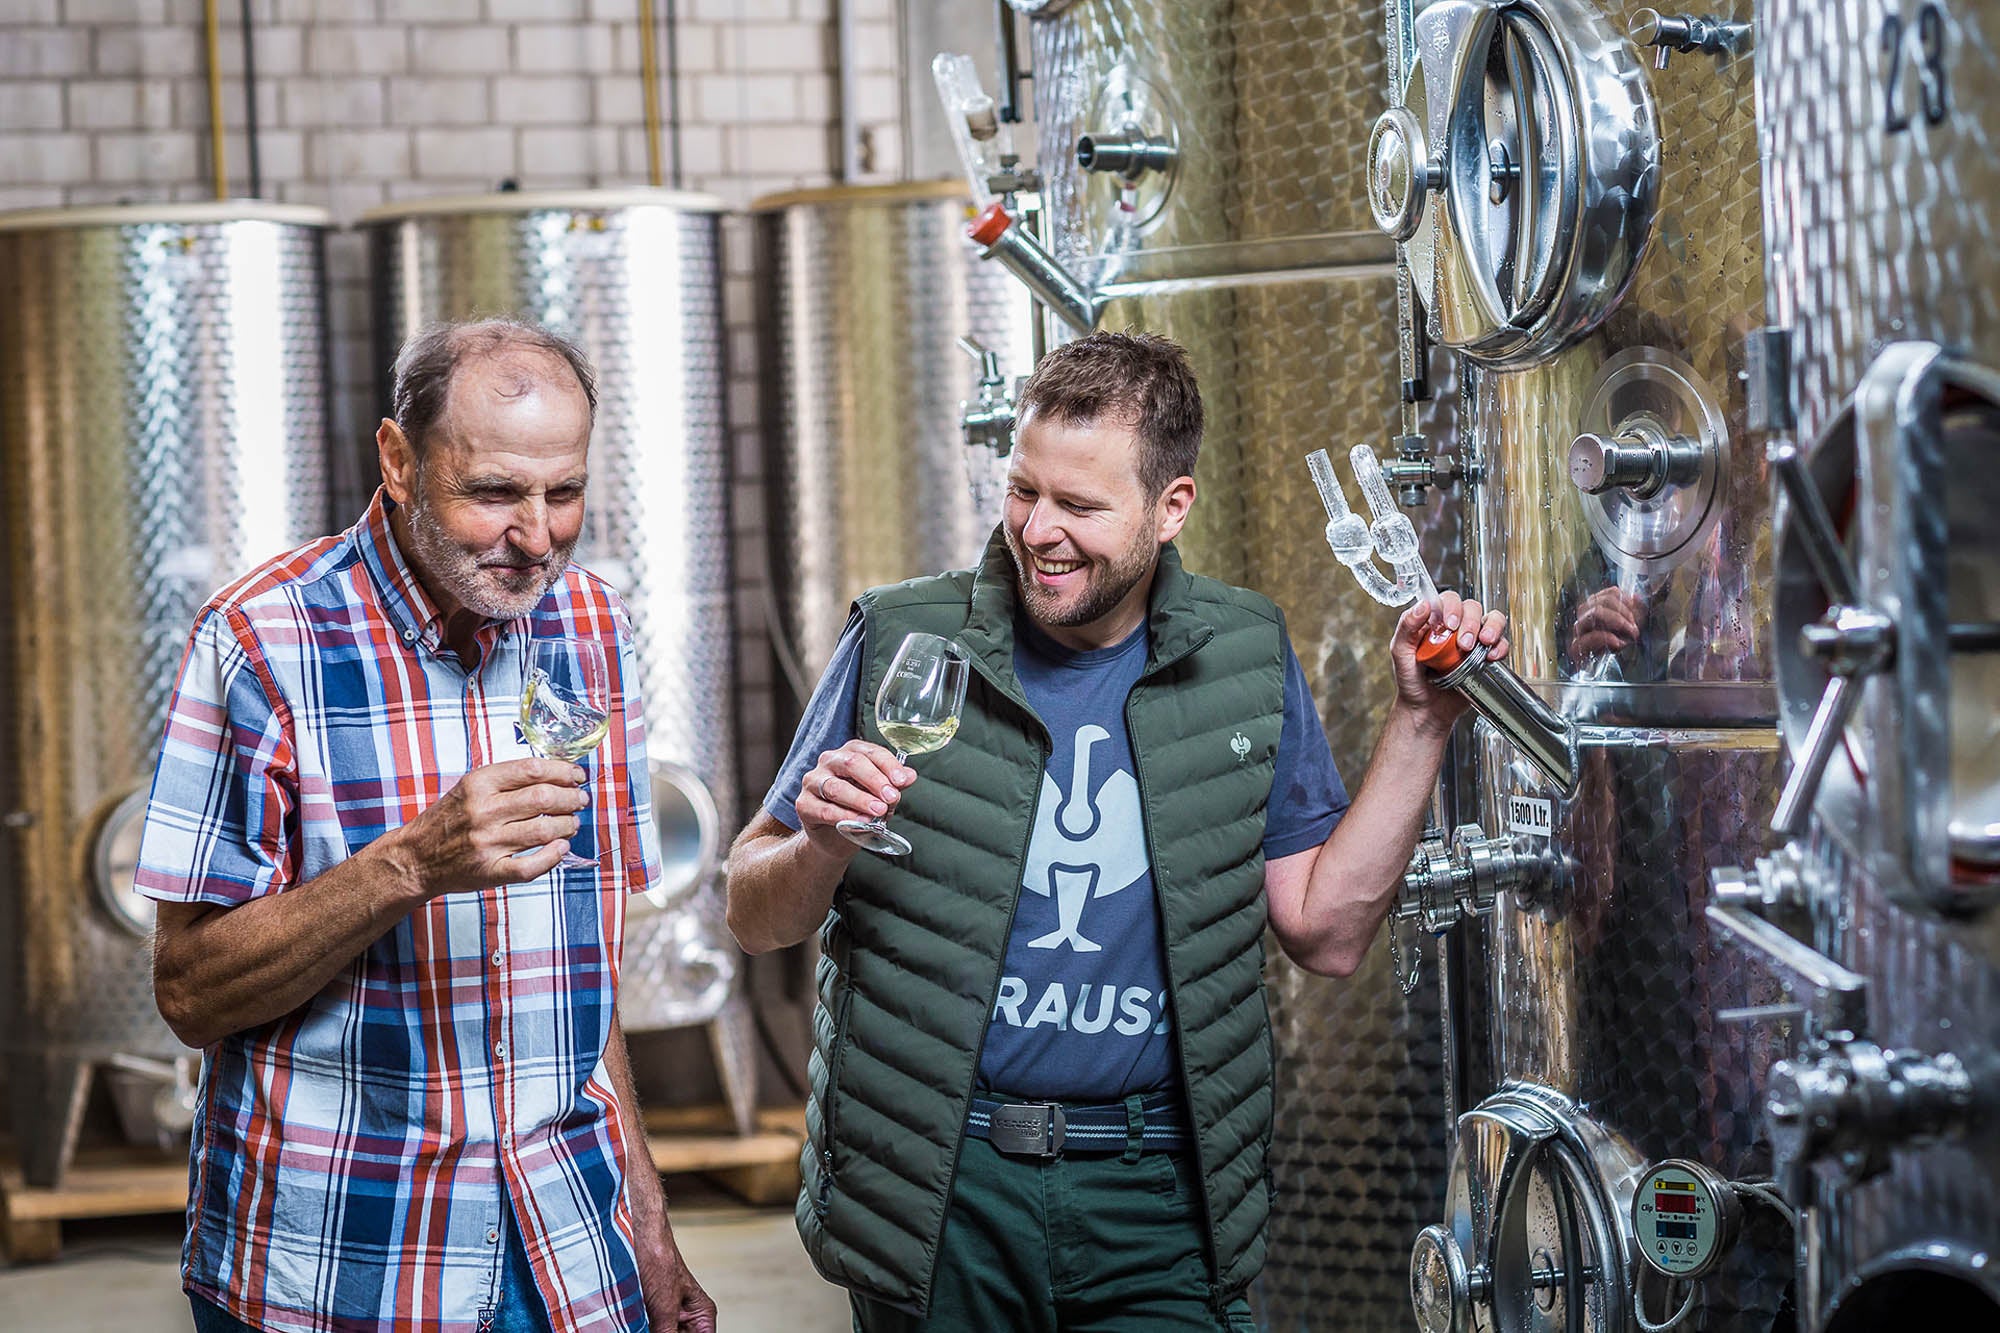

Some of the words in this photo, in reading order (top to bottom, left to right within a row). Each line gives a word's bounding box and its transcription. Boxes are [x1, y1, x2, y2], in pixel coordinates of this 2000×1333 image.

[1881, 3, 1947, 134] 23
[1510, 801, 1531, 825] 1500
[1534, 804, 1549, 827] Ltr.
